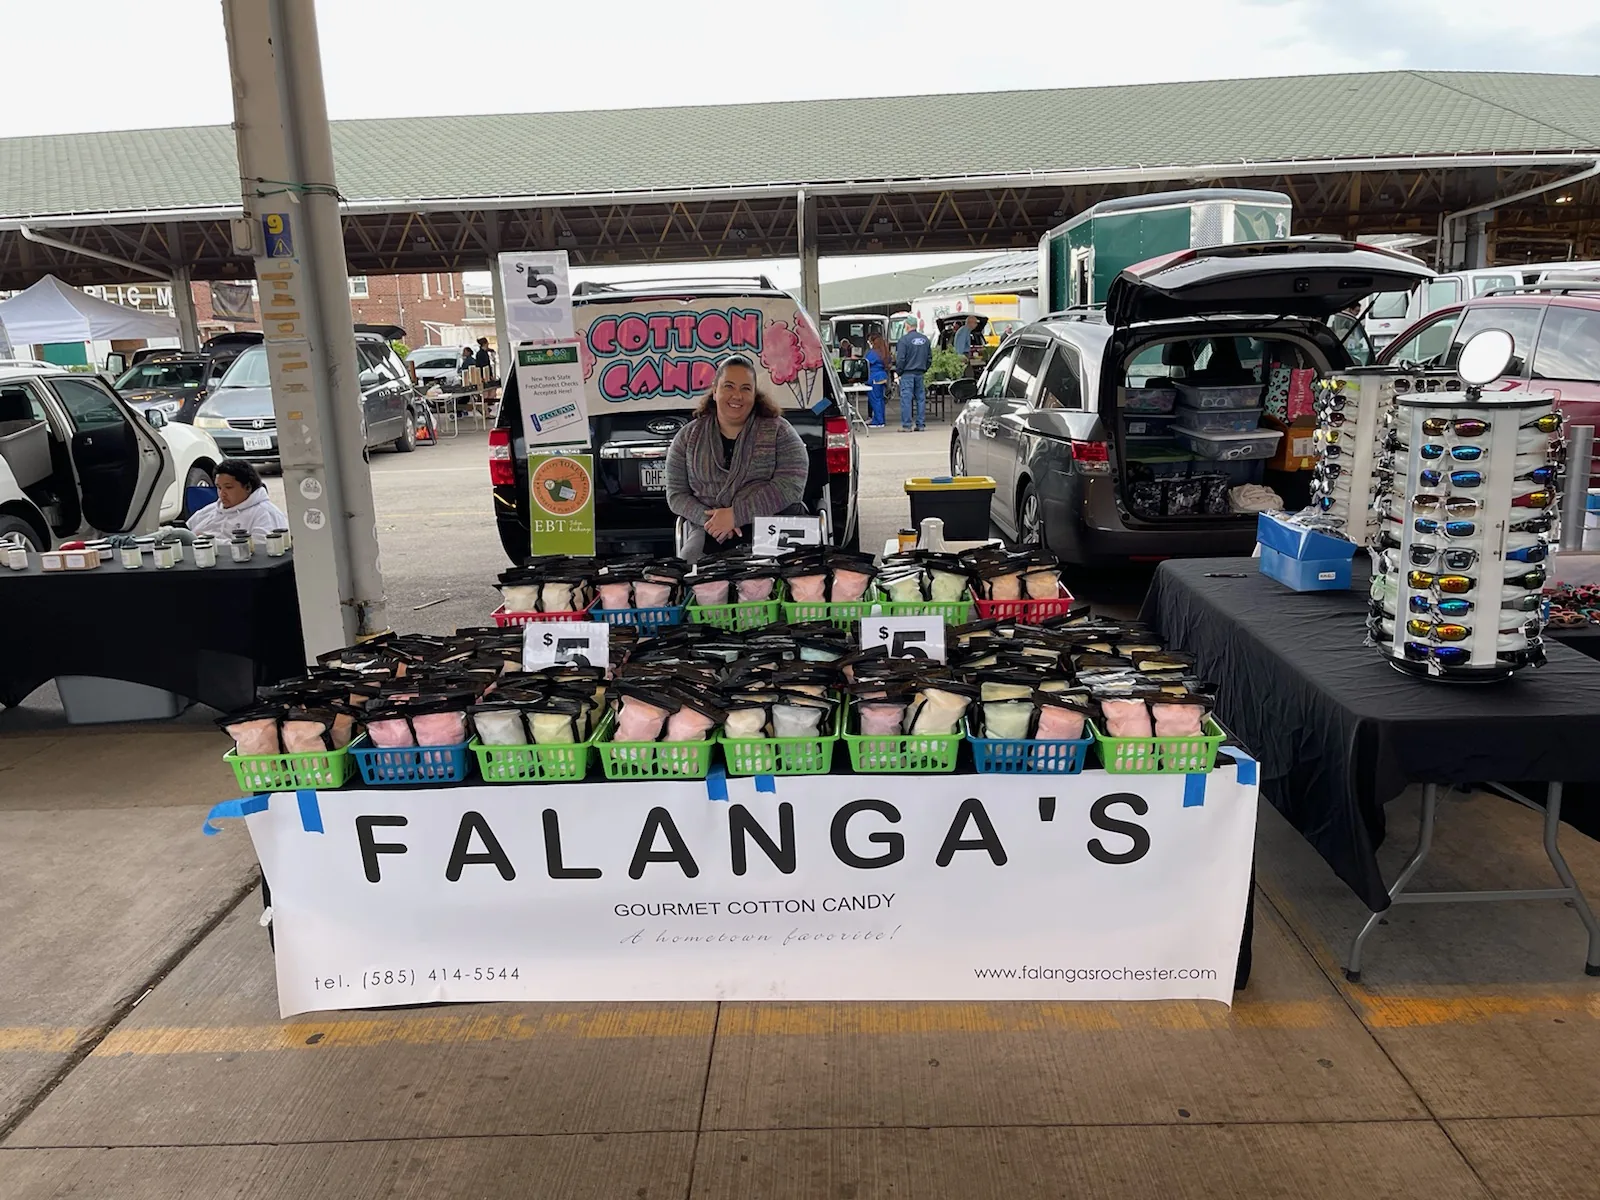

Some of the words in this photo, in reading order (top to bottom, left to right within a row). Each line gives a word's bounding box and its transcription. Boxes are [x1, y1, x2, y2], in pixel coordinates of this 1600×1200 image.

[266, 213, 284, 235] 9
[515, 263, 558, 305] $5
[589, 310, 761, 355] COTTON
[601, 358, 718, 399] CAND
[546, 404, 576, 419] COUPON
[559, 460, 587, 482] TOKENS
[645, 470, 666, 485] DHF-
[534, 519, 567, 533] EBT
[355, 792, 1151, 883] FALANGA'S
[614, 902, 721, 917] GOURMET
[727, 899, 816, 914] COTTON
[822, 892, 896, 912] CANDY
[619, 928, 646, 944] A
[655, 928, 773, 944] hometown
[783, 924, 902, 946] favorite!
[314, 975, 351, 990] tel.
[362, 969, 416, 989] (585)
[428, 966, 521, 982] 414-5544
[973, 965, 1218, 983] www.falangasrochester.com
